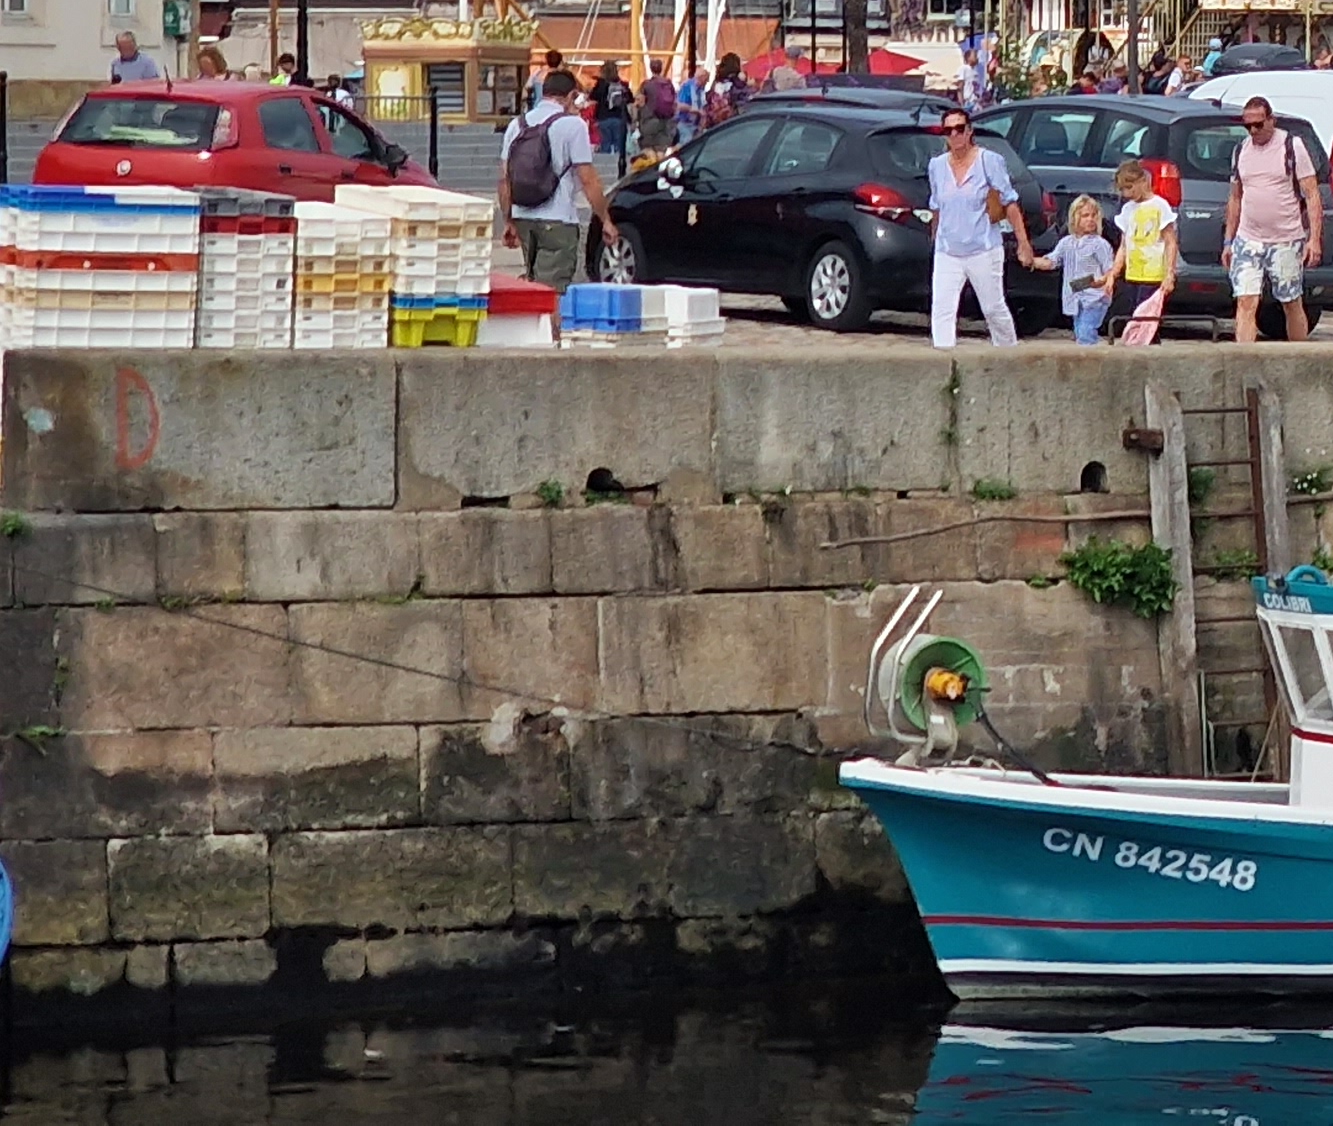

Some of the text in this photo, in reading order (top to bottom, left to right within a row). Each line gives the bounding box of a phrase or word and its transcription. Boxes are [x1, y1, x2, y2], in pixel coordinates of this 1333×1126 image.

[115, 365, 160, 471] D
[1263, 592, 1313, 614] COLIBRI
[1042, 827, 1258, 892] CN 842548
